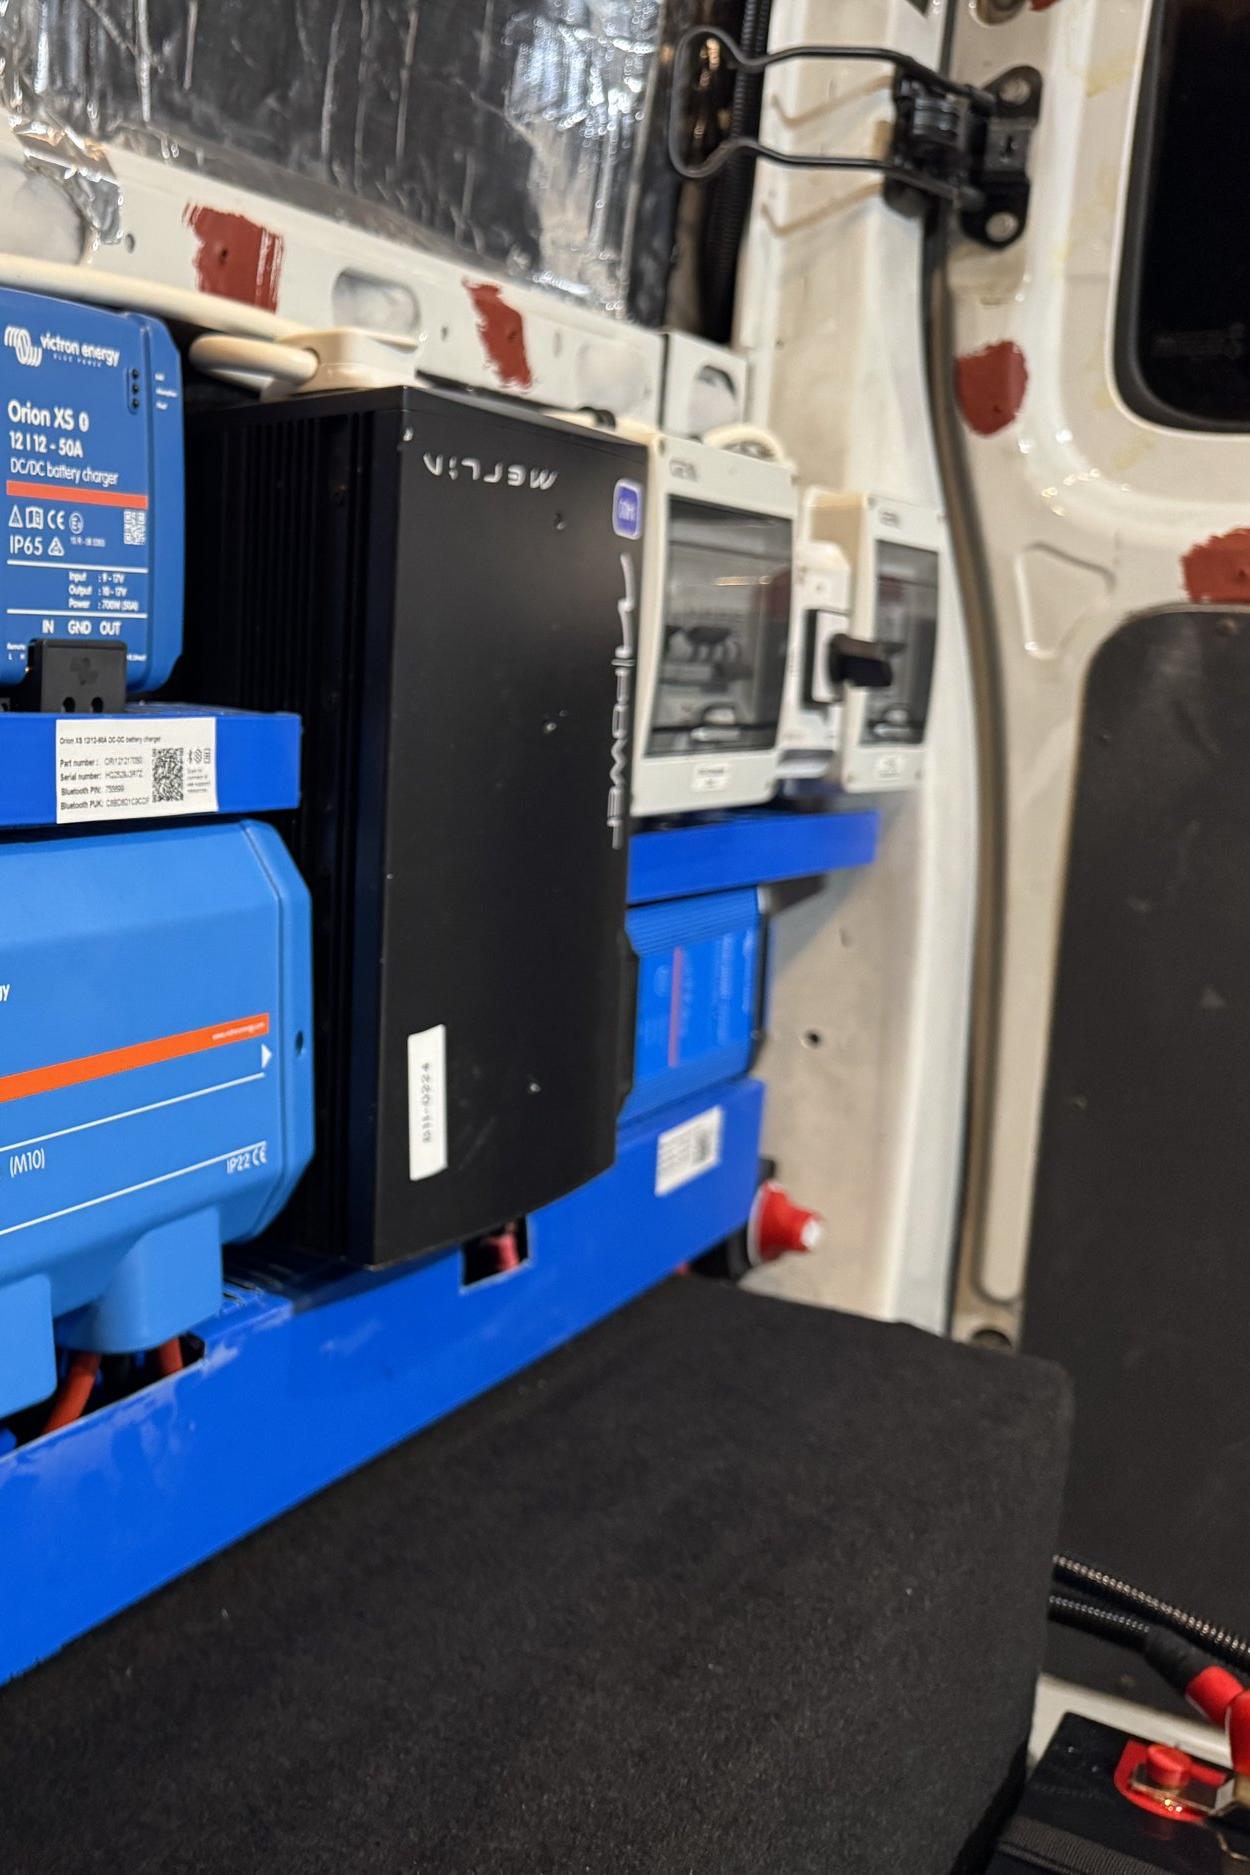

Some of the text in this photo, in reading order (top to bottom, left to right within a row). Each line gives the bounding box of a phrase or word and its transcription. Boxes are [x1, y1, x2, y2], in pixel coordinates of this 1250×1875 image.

[40, 332, 120, 368] victron energy
[7, 399, 75, 431] Orion XS
[9, 430, 24, 451] 12
[33, 434, 48, 453] 12
[58, 437, 84, 458] 50A
[10, 457, 119, 488] DC/DC battery charger
[9, 534, 44, 556] IP65
[68, 571, 87, 583] Input
[68, 584, 93, 597] Output
[68, 598, 91, 609] Power
[42, 619, 54, 634] IN
[68, 620, 92, 635] GND
[100, 621, 121, 635] OUT
[59, 759, 72, 768] Part
[60, 772, 77, 781] Serial
[61, 787, 89, 796] Bluetooth
[60, 801, 88, 811] Bluetooth
[9, 1147, 46, 1180] (M10)
[226, 1151, 250, 1174] IP22
